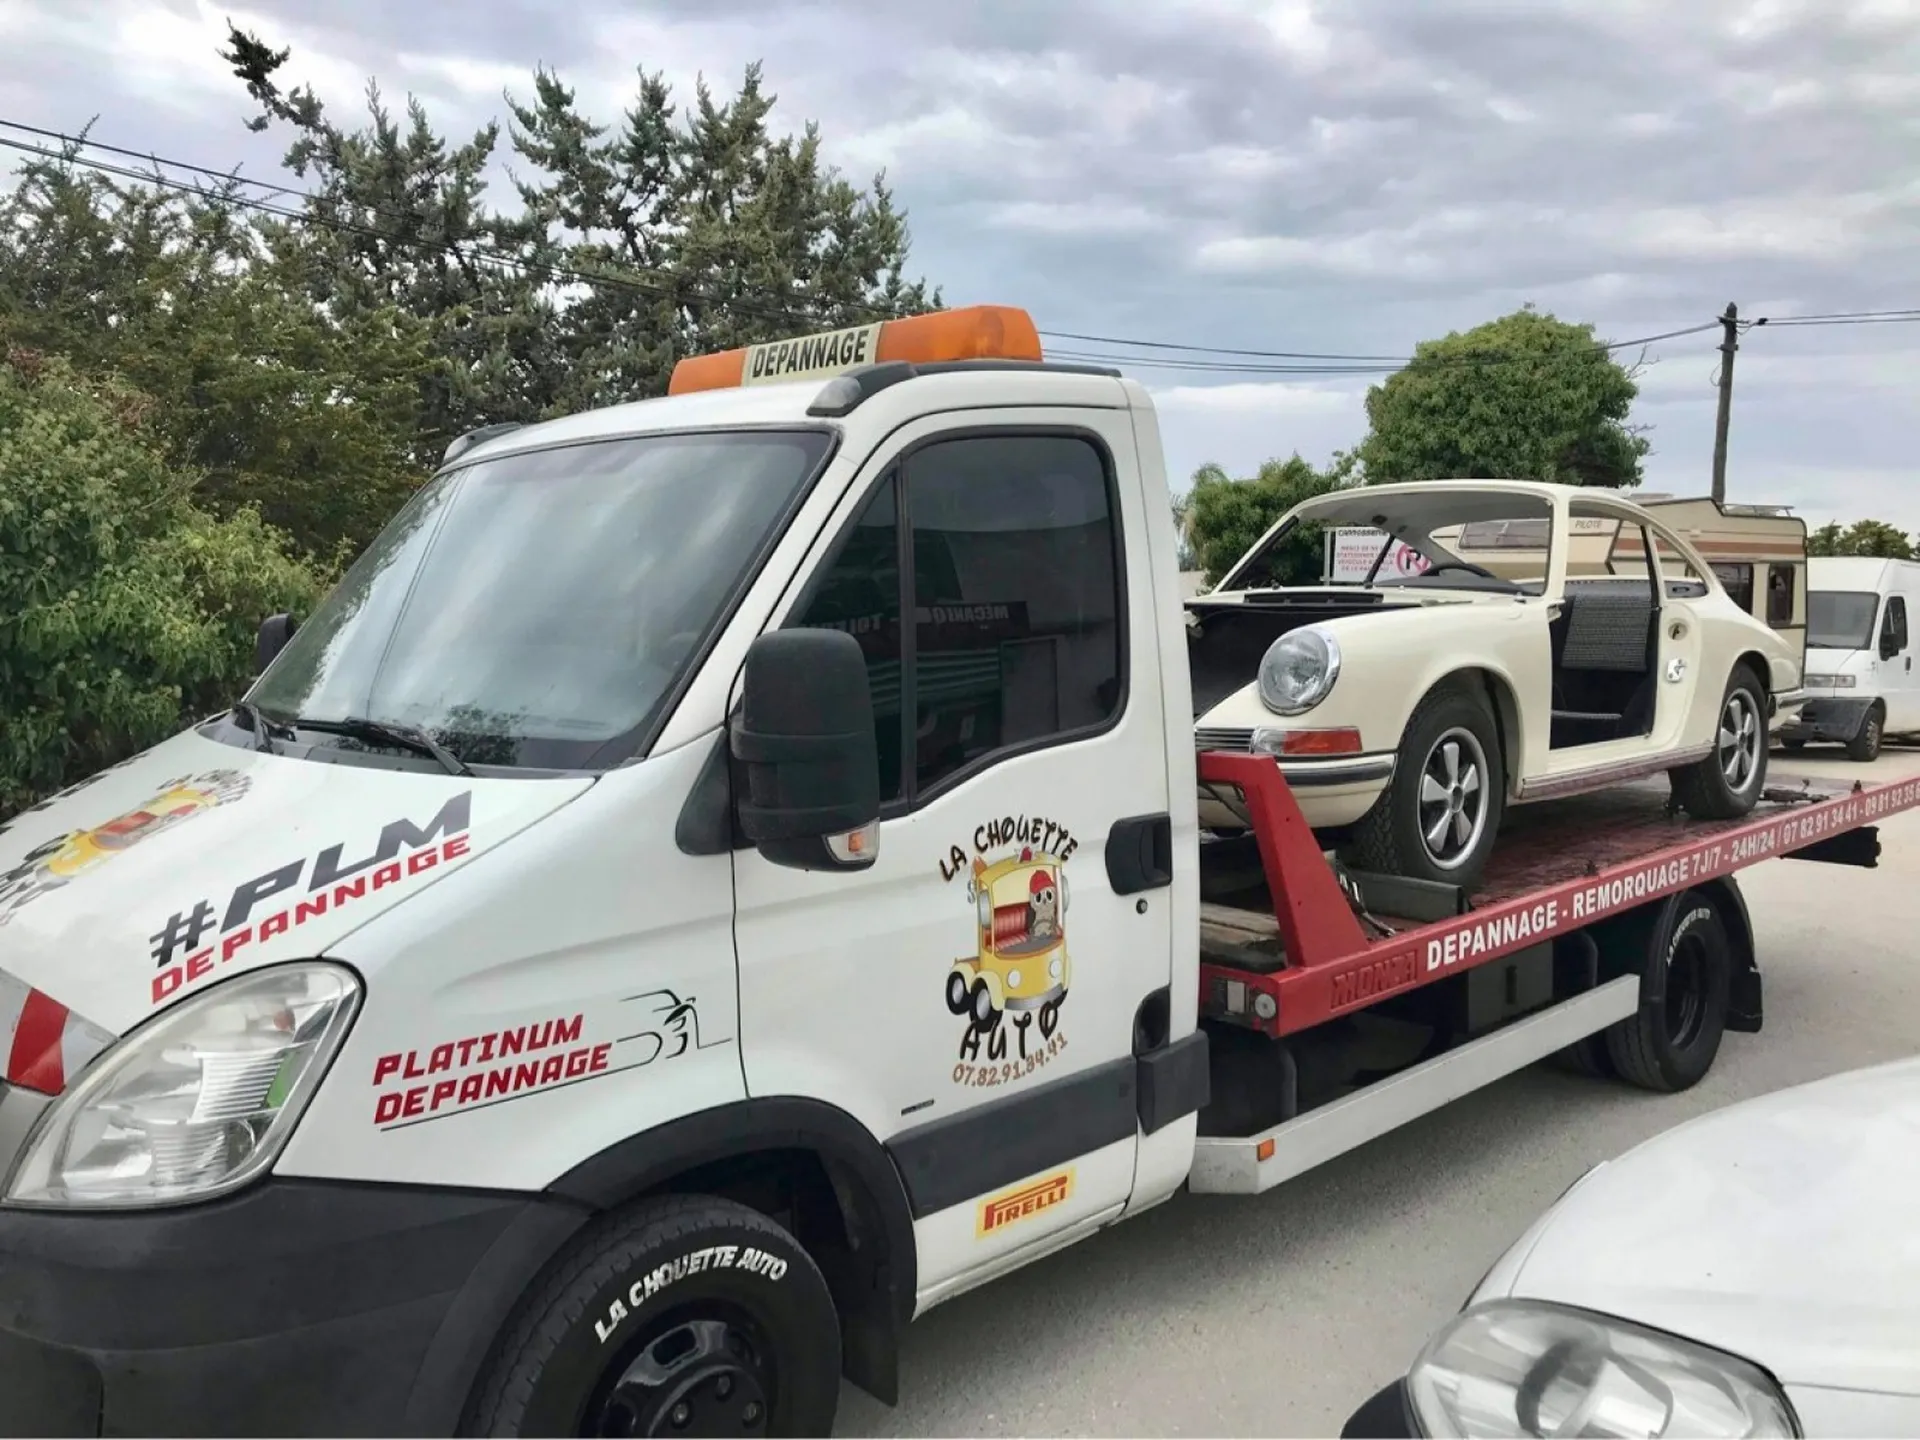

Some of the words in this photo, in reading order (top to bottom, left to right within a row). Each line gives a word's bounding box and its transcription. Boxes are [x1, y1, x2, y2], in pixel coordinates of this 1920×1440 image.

[752, 330, 869, 378] DEPANNAGE
[149, 790, 472, 968] #PLM
[939, 844, 967, 882] LA
[974, 814, 1079, 862] CHOUETTE
[152, 834, 471, 1004] DEPANNAGE
[1426, 901, 1558, 972] DEPANNAGE
[1573, 856, 1689, 920] REMORQUAGE
[1692, 846, 1722, 877] 7J/7
[1731, 829, 1776, 863] 24H/24
[372, 1014, 583, 1086] PLATINUM
[959, 995, 1066, 1062] AUTO
[374, 1043, 612, 1124] DEPANNAGE
[983, 1175, 1068, 1232] PIRELLI
[594, 1298, 628, 1344] LA
[629, 1245, 739, 1307] CHOUETTE
[736, 1247, 788, 1281] AUTO
